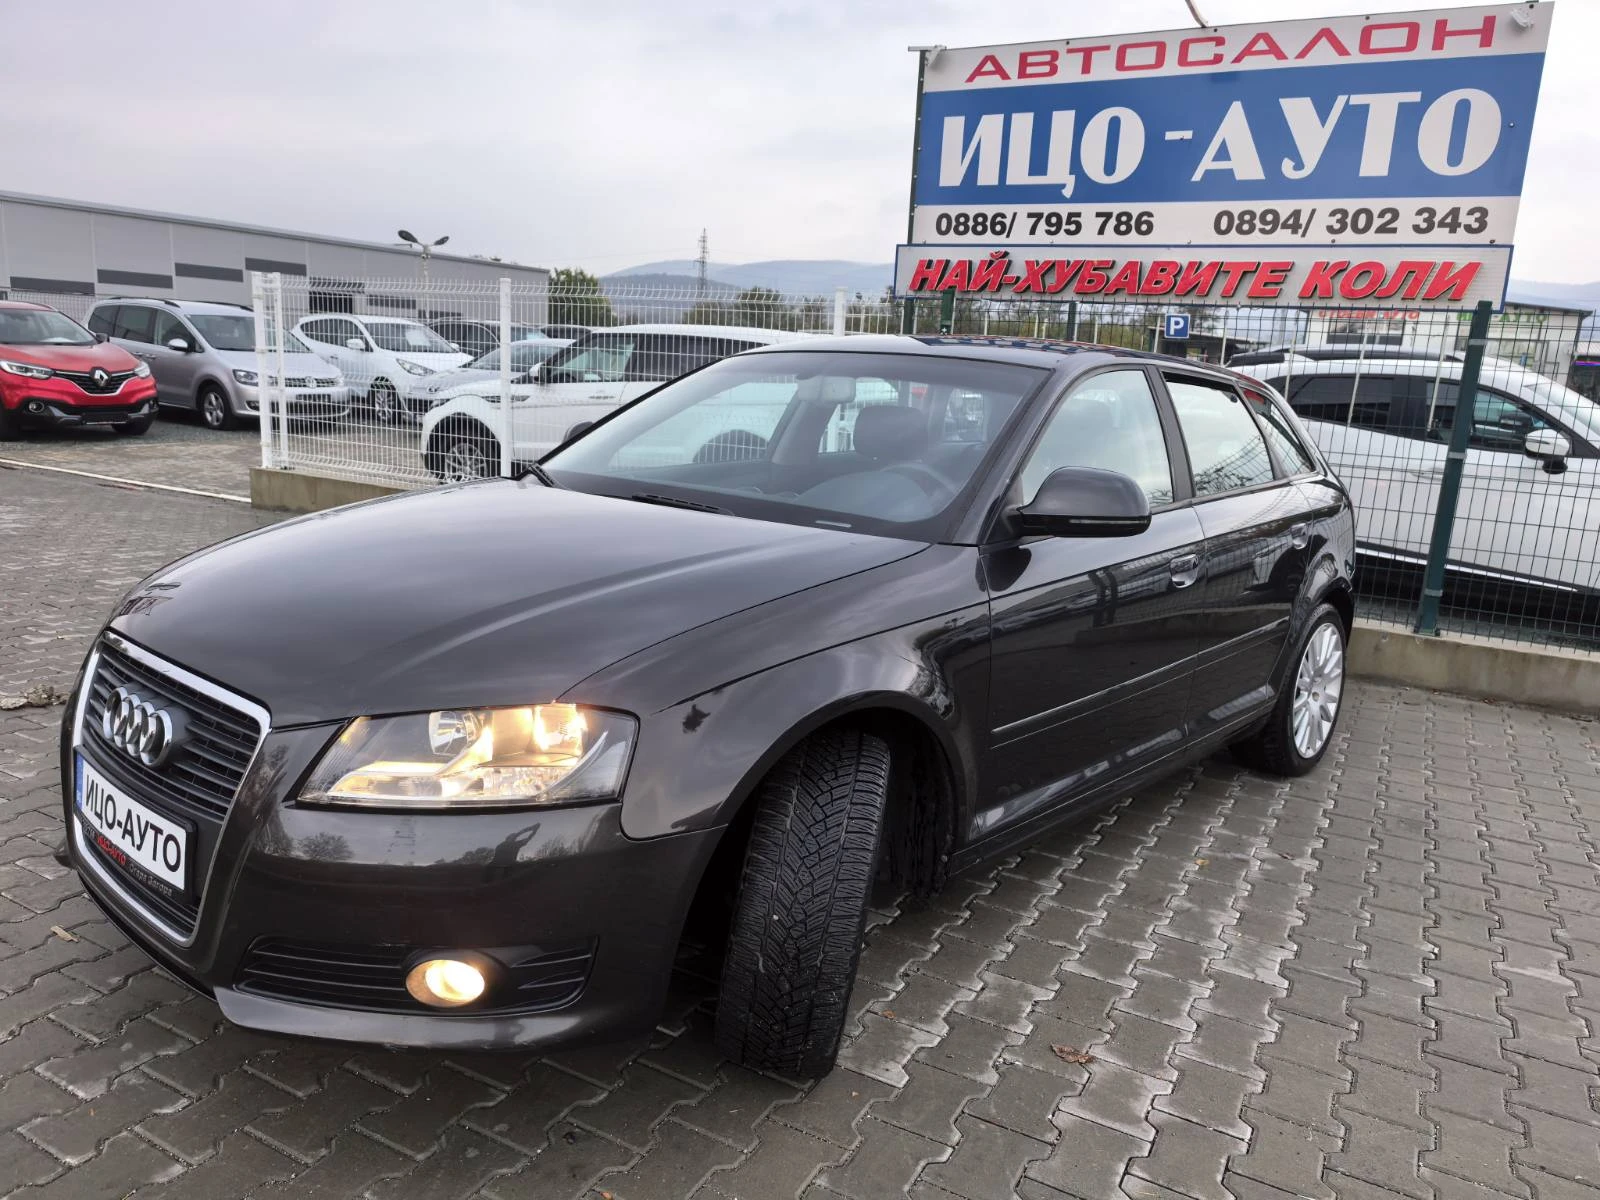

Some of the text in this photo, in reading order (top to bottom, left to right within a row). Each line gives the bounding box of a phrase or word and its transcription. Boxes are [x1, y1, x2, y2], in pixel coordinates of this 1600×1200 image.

[965, 15, 1496, 83] АВТОСАЛОН
[935, 206, 1489, 237] 0886/ 795 786 0894/ 302 343
[908, 250, 1483, 301] НАЙ-ХУБАВИТЕ КОЛИ
[1169, 317, 1184, 335] P
[85, 774, 182, 873] ИЦО-АУТО
